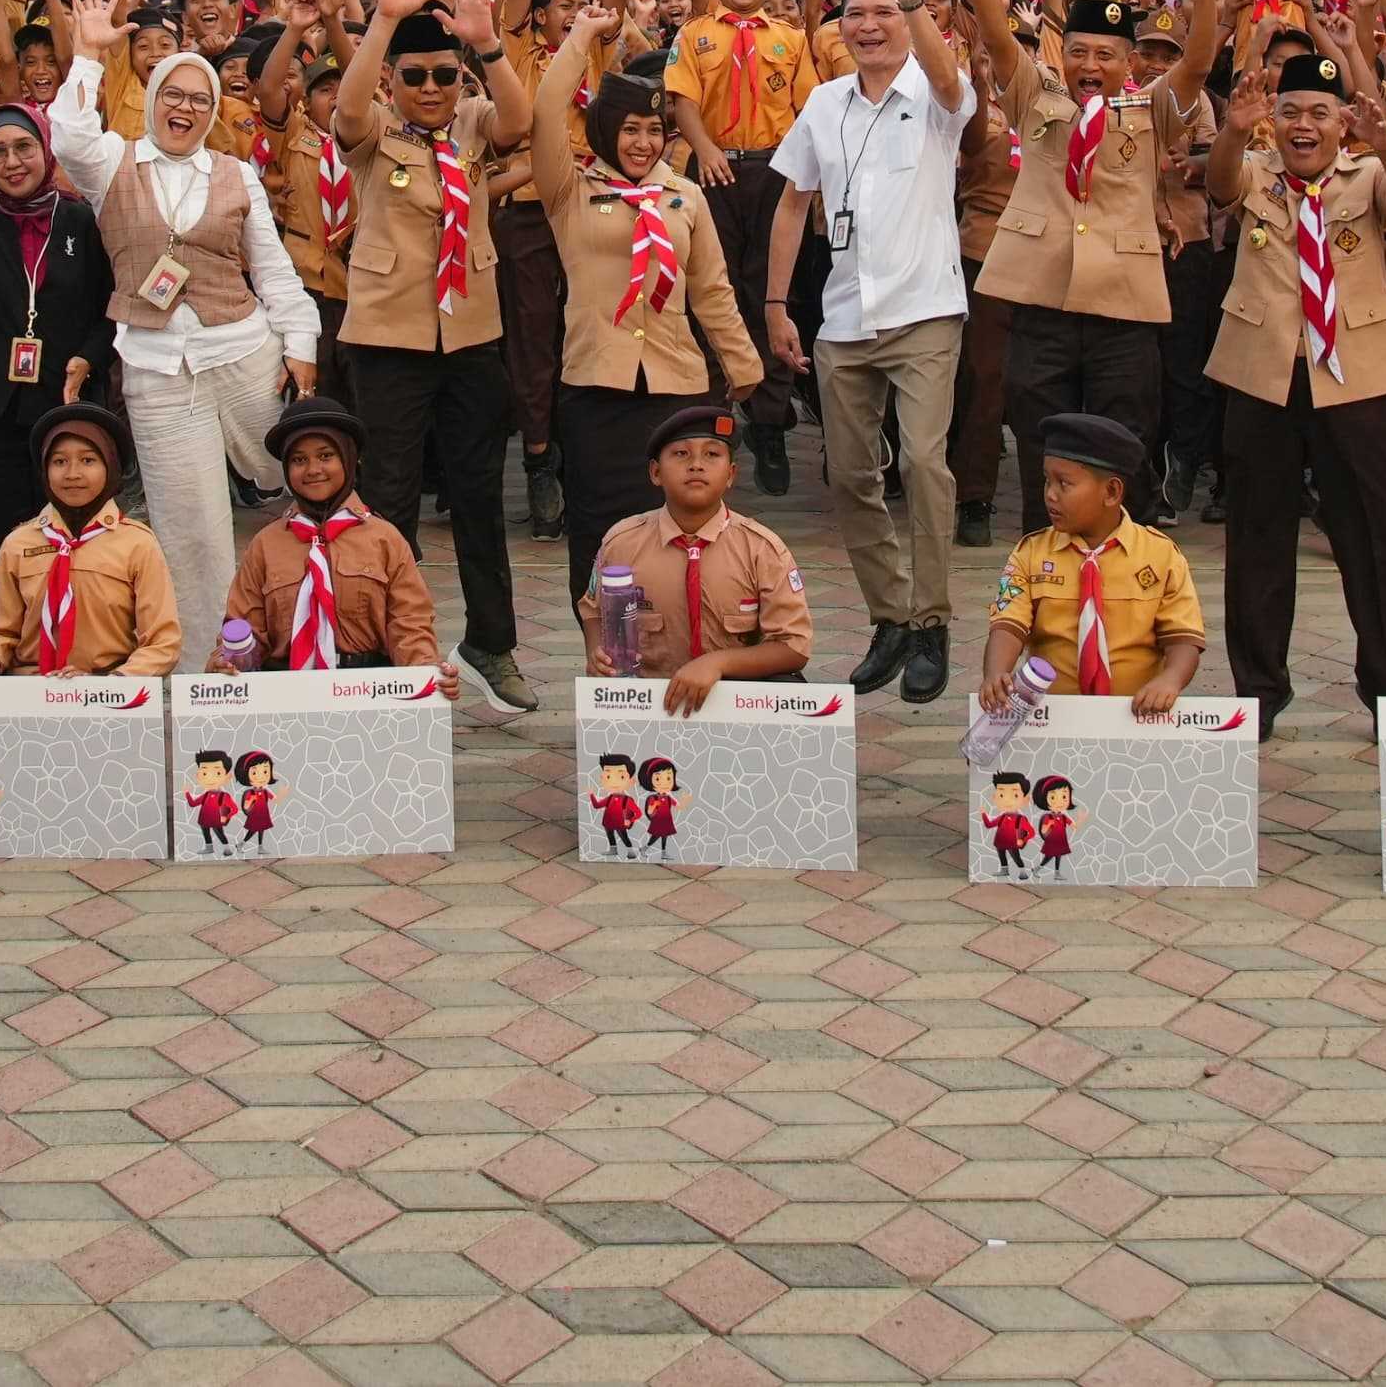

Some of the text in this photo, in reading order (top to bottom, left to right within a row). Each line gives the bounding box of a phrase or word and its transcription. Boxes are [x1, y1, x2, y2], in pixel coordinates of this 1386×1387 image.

[45, 689, 126, 707] bankjatim
[190, 681, 415, 699] SimPel bankjatim
[224, 698, 249, 706] Pelajar
[594, 687, 818, 713] SimPel bankjatim
[628, 703, 653, 711] Pelajar
[1135, 709, 1221, 728] bankjatim
